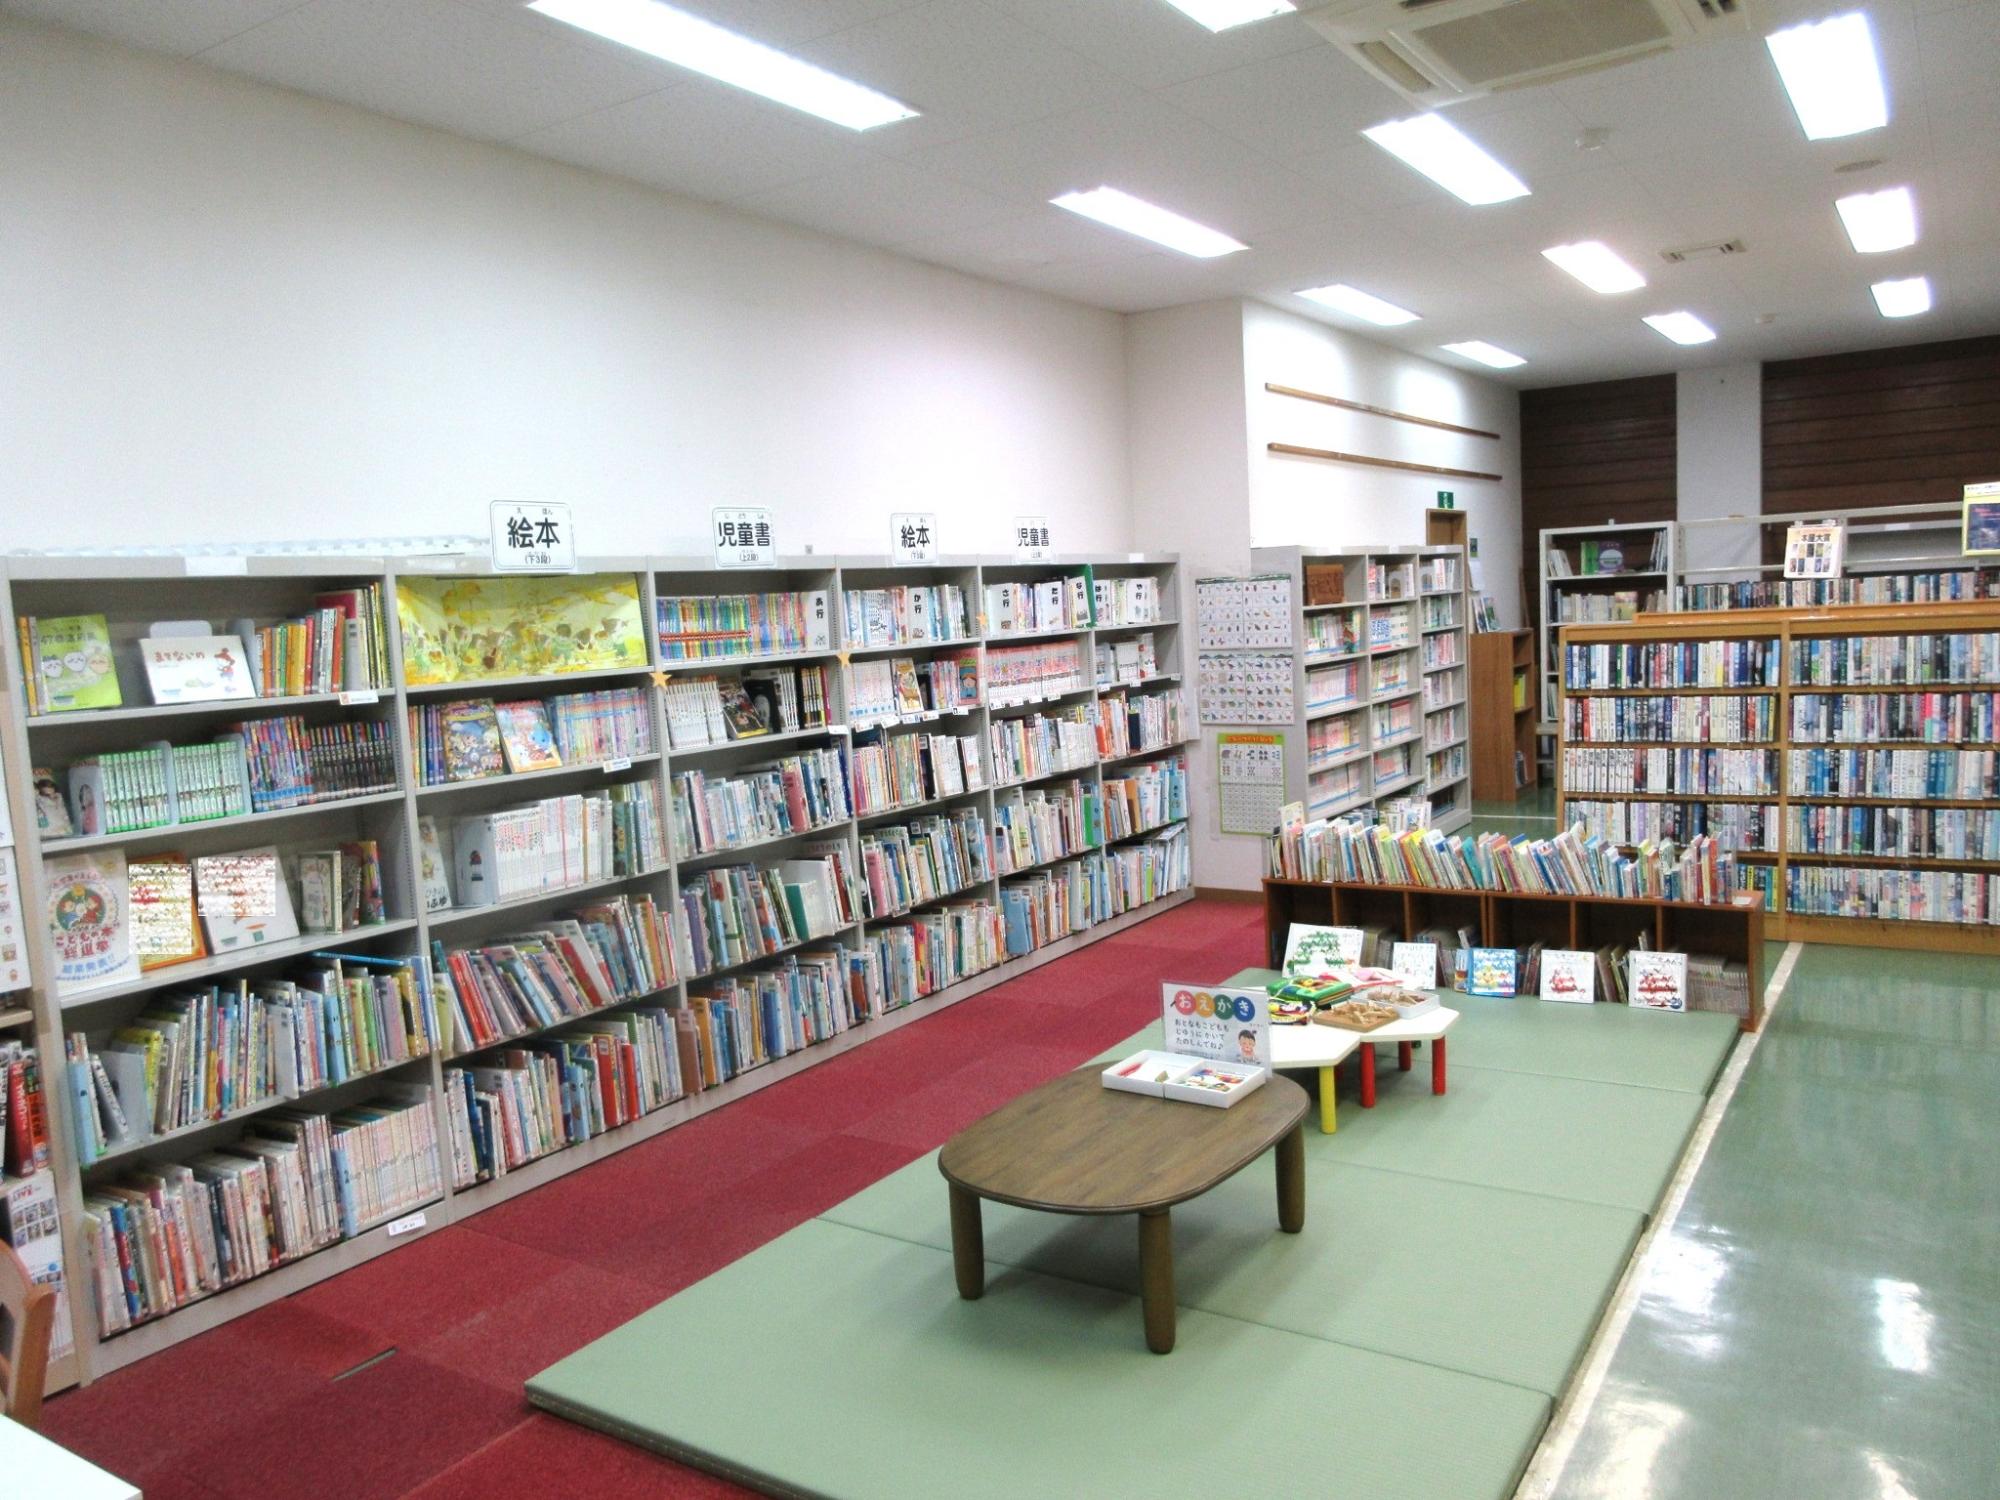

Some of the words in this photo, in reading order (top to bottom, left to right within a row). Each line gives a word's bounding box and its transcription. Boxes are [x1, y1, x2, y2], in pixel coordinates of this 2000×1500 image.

[507, 516, 561, 549] 絵本
[718, 521, 771, 548] 児童書
[900, 524, 931, 549] 絵本
[1017, 527, 1050, 547] 児童書
[815, 597, 824, 619] あ行
[913, 594, 922, 614] か行
[154, 650, 205, 663] まてないの
[1178, 993, 1250, 1017] おえかき
[1175, 1018, 1230, 1032] おとなもこどもも
[1176, 1028, 1202, 1038] じゆうに
[1204, 1031, 1225, 1041] かいて
